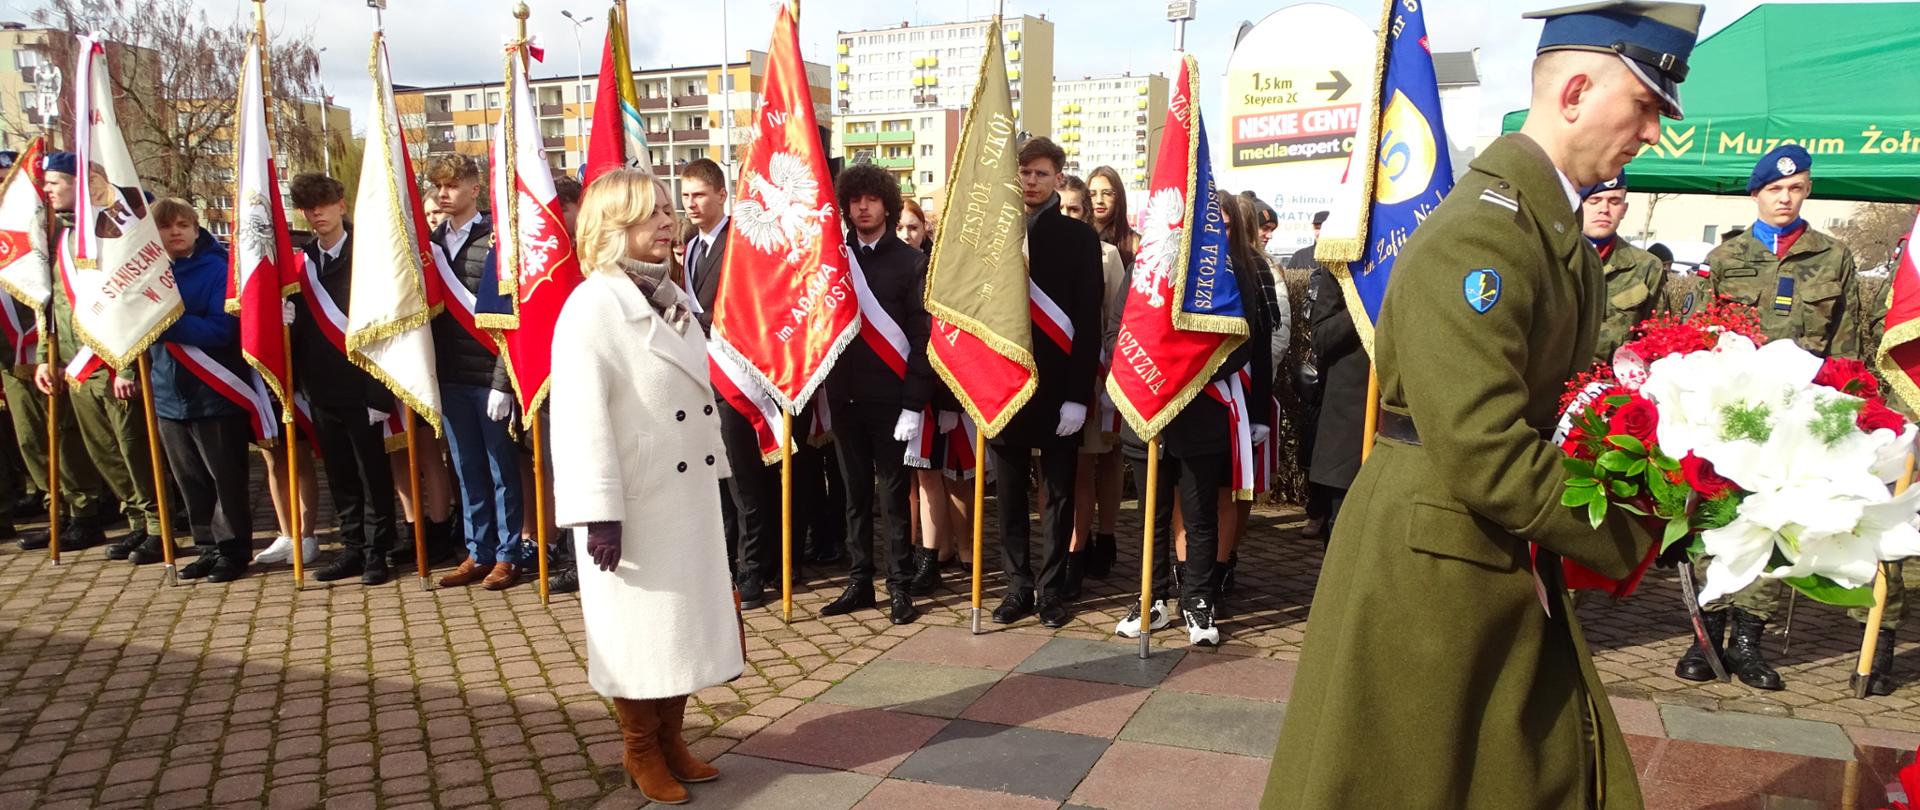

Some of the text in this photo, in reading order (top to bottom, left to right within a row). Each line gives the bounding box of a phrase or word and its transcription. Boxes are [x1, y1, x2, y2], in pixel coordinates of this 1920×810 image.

[1391, 15, 1406, 40] nr
[1252, 72, 1293, 92] 1,5 km
[1244, 94, 1284, 107] Steyera
[767, 109, 788, 128] Nr
[1238, 107, 1358, 139] NISKIE CENY!
[1239, 138, 1340, 161] mediaexpert
[1379, 129, 1411, 182] 5
[960, 112, 1014, 248] ZESPÓŁ SZKÓŁ
[1376, 226, 1408, 264] Zofii
[102, 240, 164, 299] STANISŁAWA
[1194, 243, 1219, 309] SZKOŁA
[791, 263, 837, 325] ADAMA
